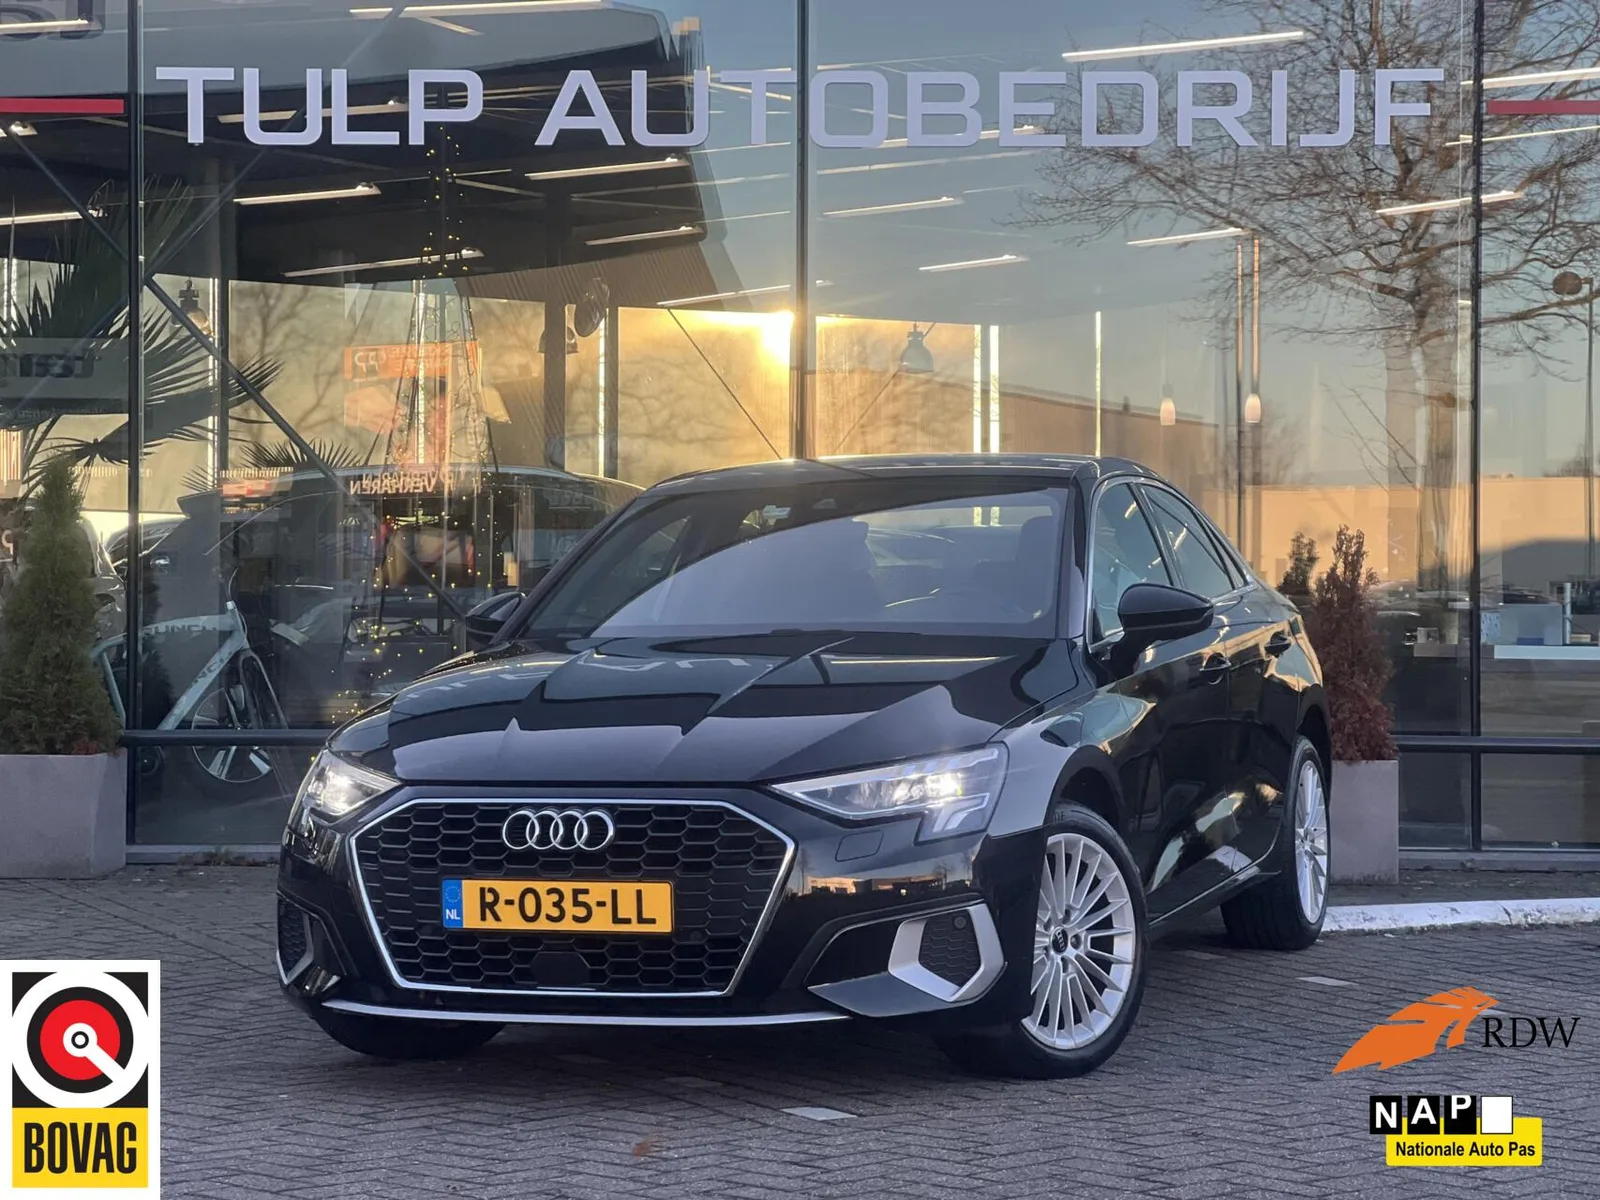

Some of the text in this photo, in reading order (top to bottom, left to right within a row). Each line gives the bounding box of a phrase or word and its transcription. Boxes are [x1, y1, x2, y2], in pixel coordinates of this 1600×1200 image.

[156, 67, 1444, 149] TULP AUTOBEDRIJF
[446, 887, 656, 924] NL R-035-LL
